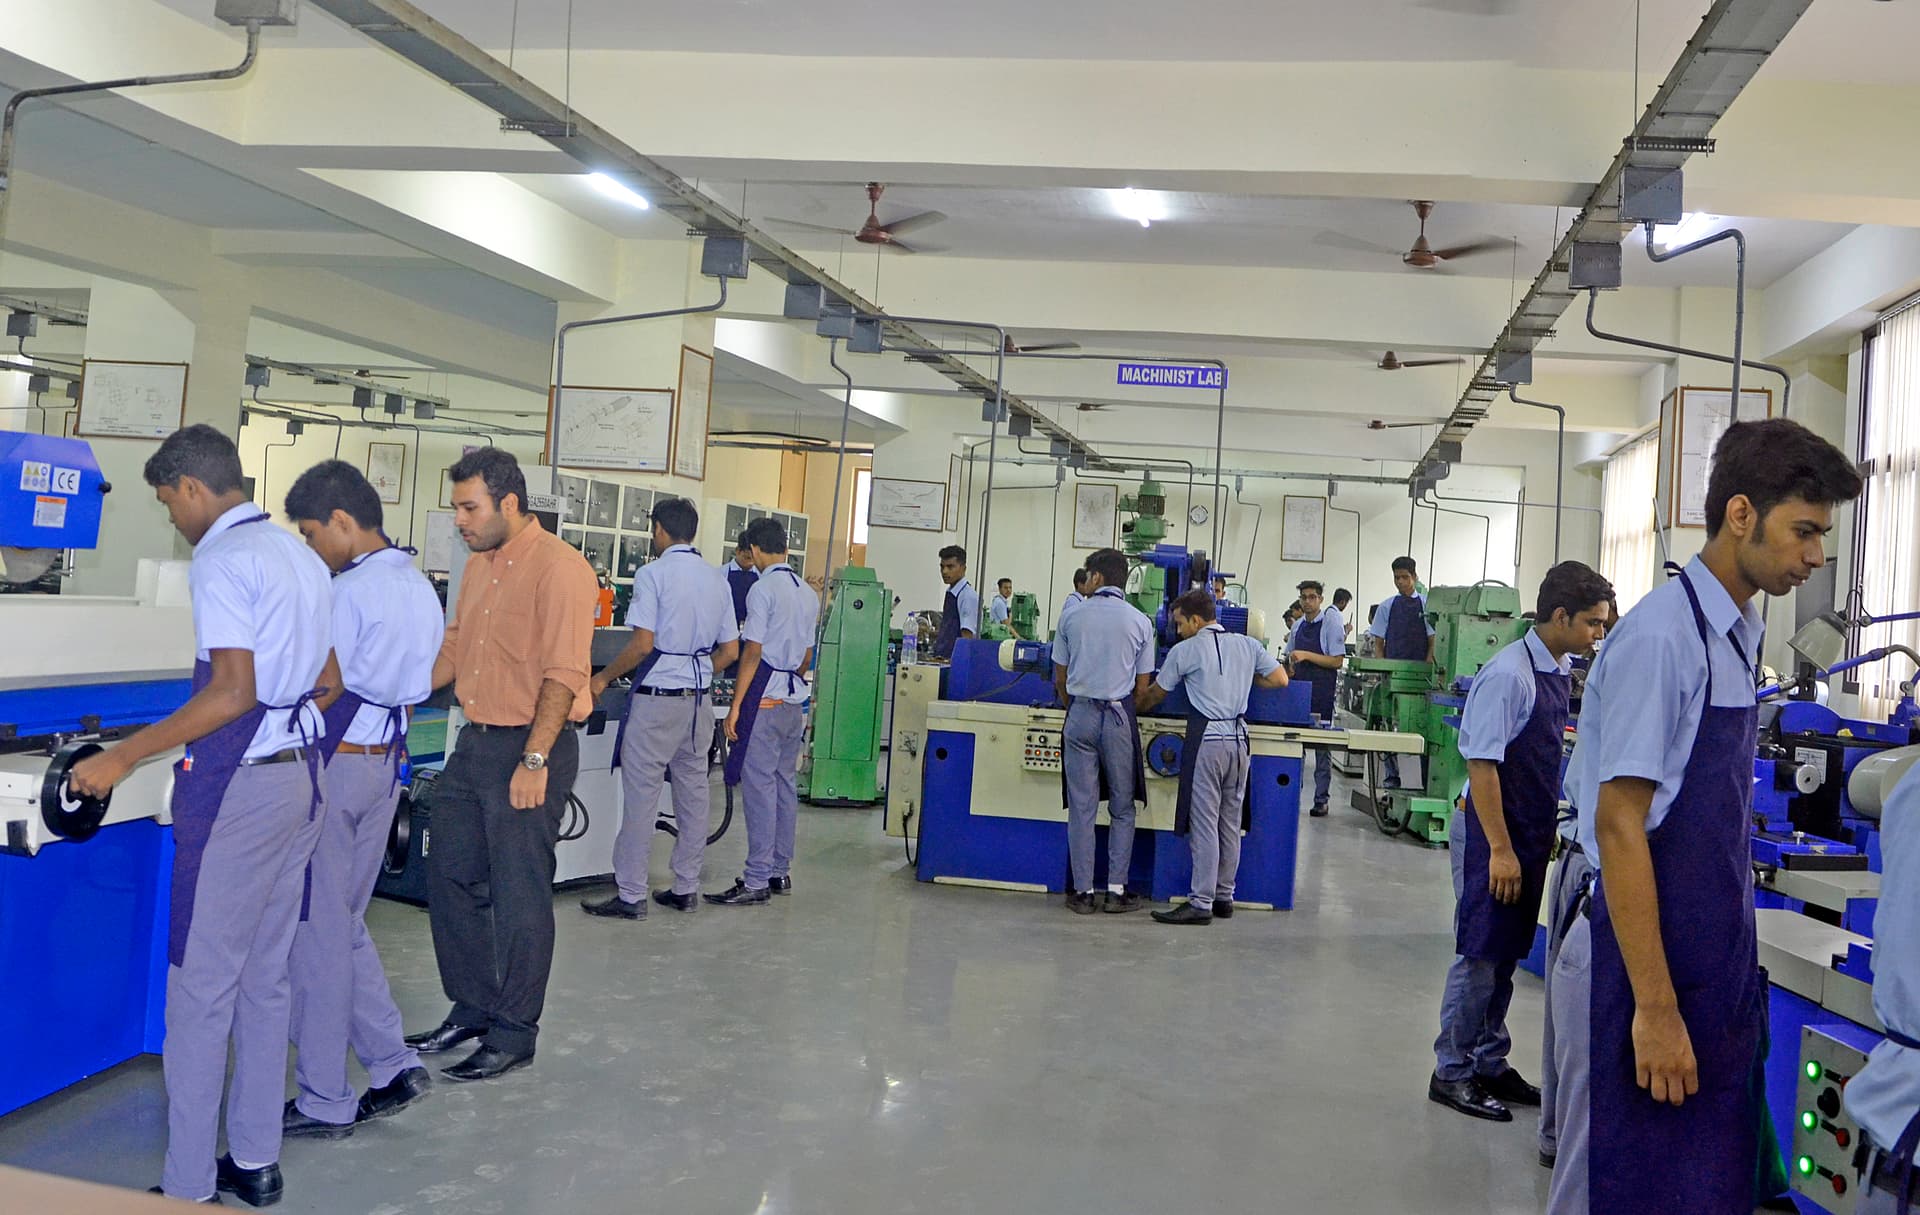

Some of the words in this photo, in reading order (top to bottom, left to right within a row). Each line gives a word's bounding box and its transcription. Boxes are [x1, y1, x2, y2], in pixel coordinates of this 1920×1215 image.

[1122, 367, 1195, 385] MACHINIST
[1198, 370, 1223, 386] LAB
[57, 471, 76, 490] CE
